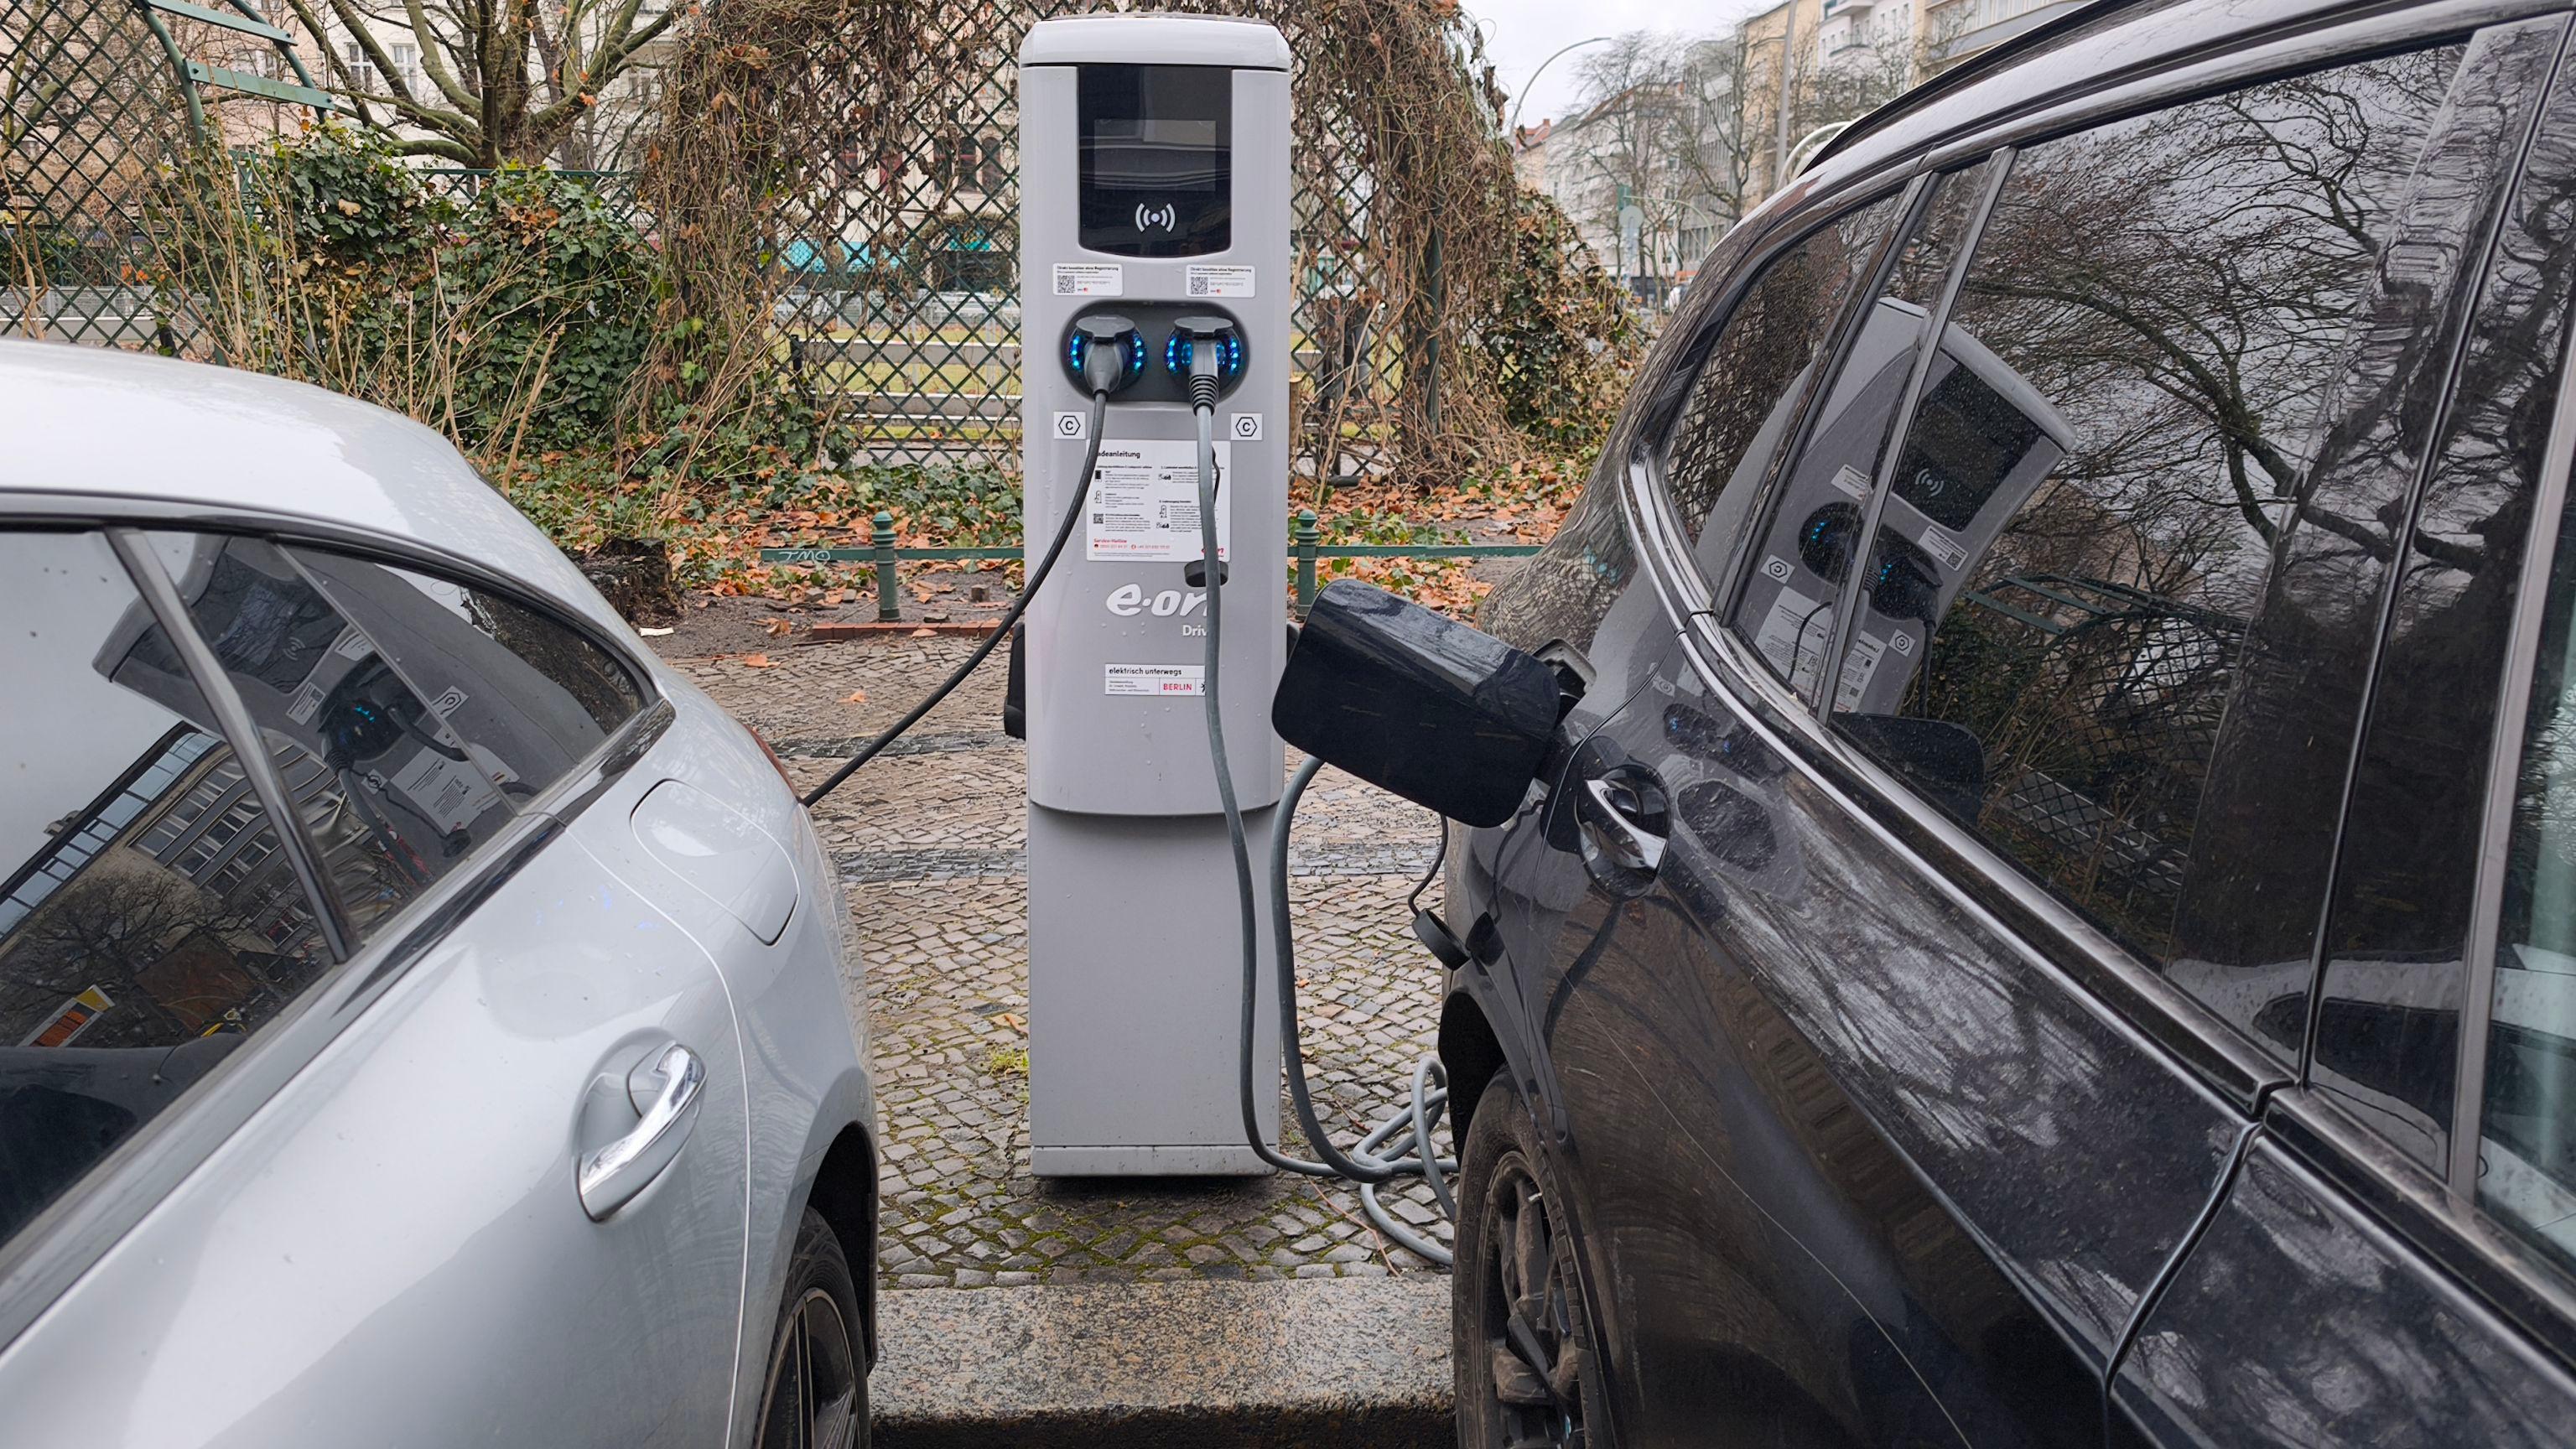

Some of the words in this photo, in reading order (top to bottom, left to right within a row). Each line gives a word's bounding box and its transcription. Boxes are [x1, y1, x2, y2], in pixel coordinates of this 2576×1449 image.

[1065, 420, 1073, 430] C
[1242, 422, 1250, 432] C
[1097, 450, 1140, 459] adeanleitung
[1182, 624, 1208, 636] Driv
